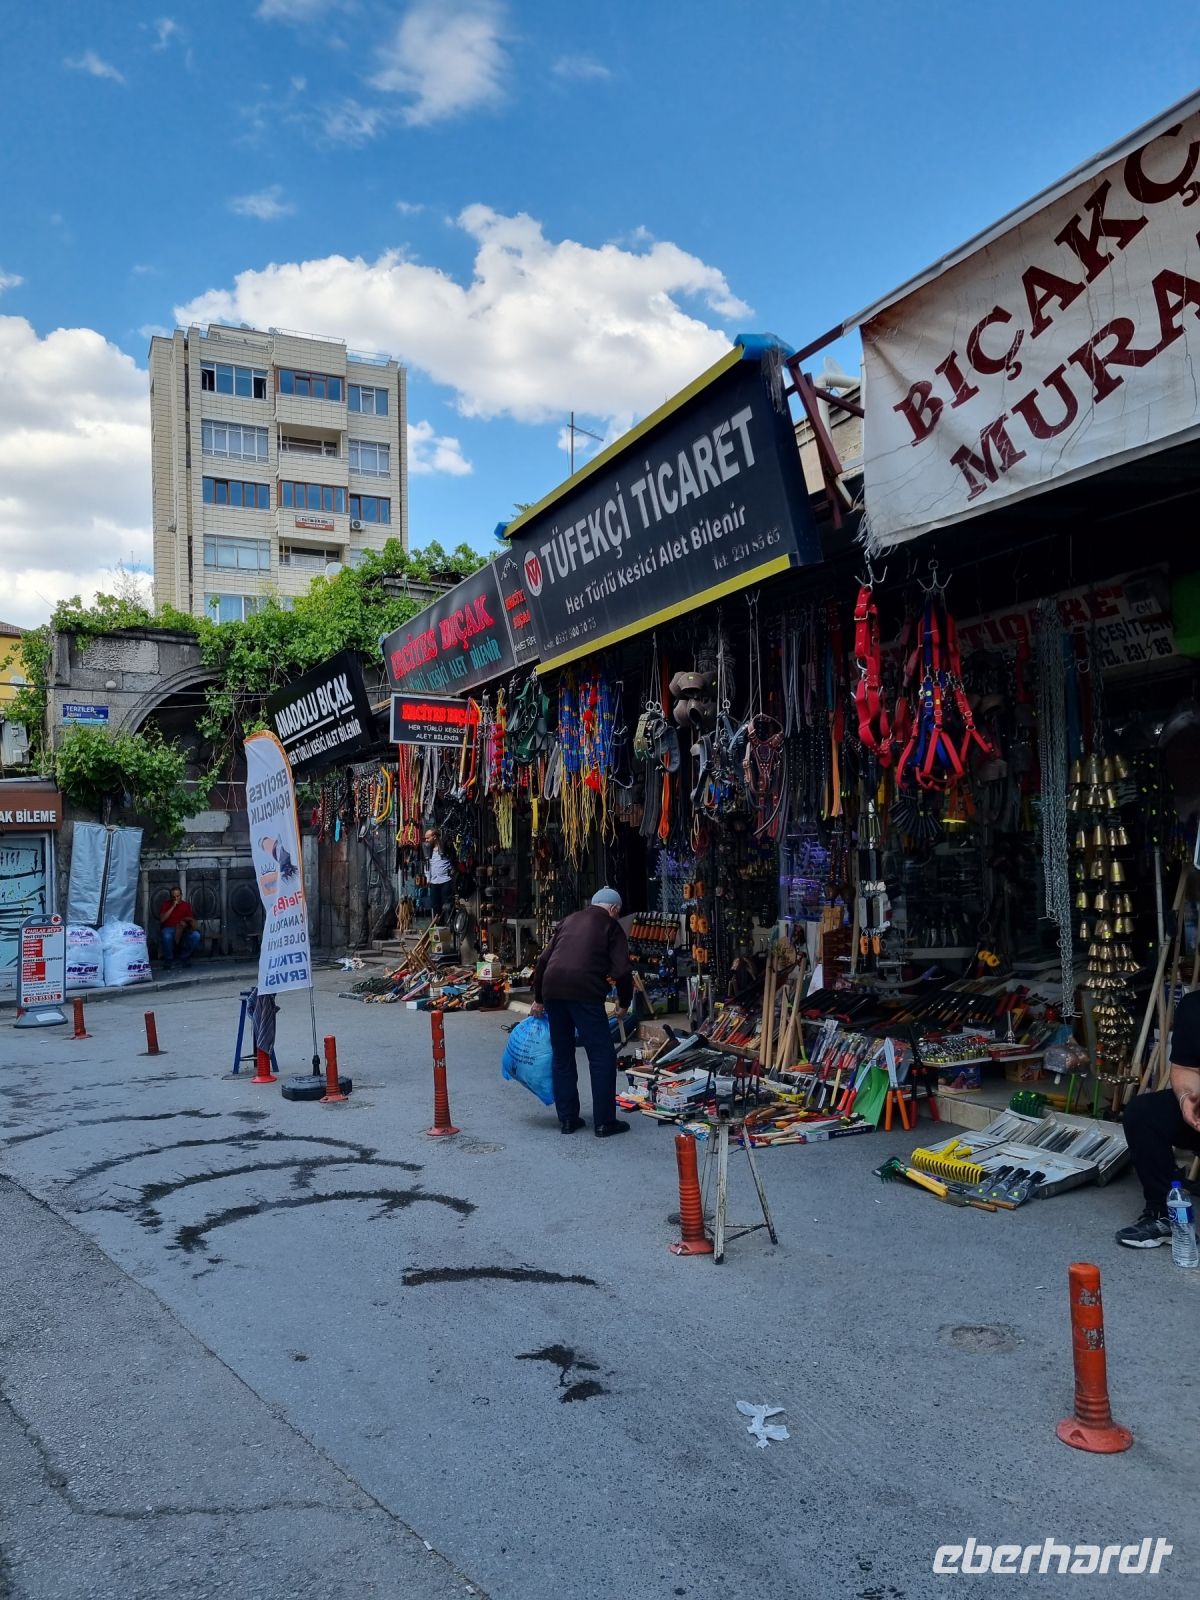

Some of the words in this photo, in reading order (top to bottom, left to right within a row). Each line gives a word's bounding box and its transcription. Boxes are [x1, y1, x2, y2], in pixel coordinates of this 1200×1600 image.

[893, 112, 1200, 447] BIÇAKÇ
[949, 233, 1200, 501] MURA
[540, 482, 631, 584] TÜFEKÇİ
[630, 405, 756, 528] TİCARET
[565, 593, 585, 615] Her
[585, 571, 617, 604] Türlü
[617, 551, 657, 587] Kesici
[659, 537, 689, 565] Alet
[691, 501, 745, 550] Bilenir
[439, 593, 496, 650] BIÇAK
[1153, 637, 1173, 656] 85
[274, 691, 319, 740] ANADOLU
[316, 673, 353, 719] BIÇAK
[423, 724, 443, 732] TÜRLÜ
[16, 808, 57, 823] BİLEME
